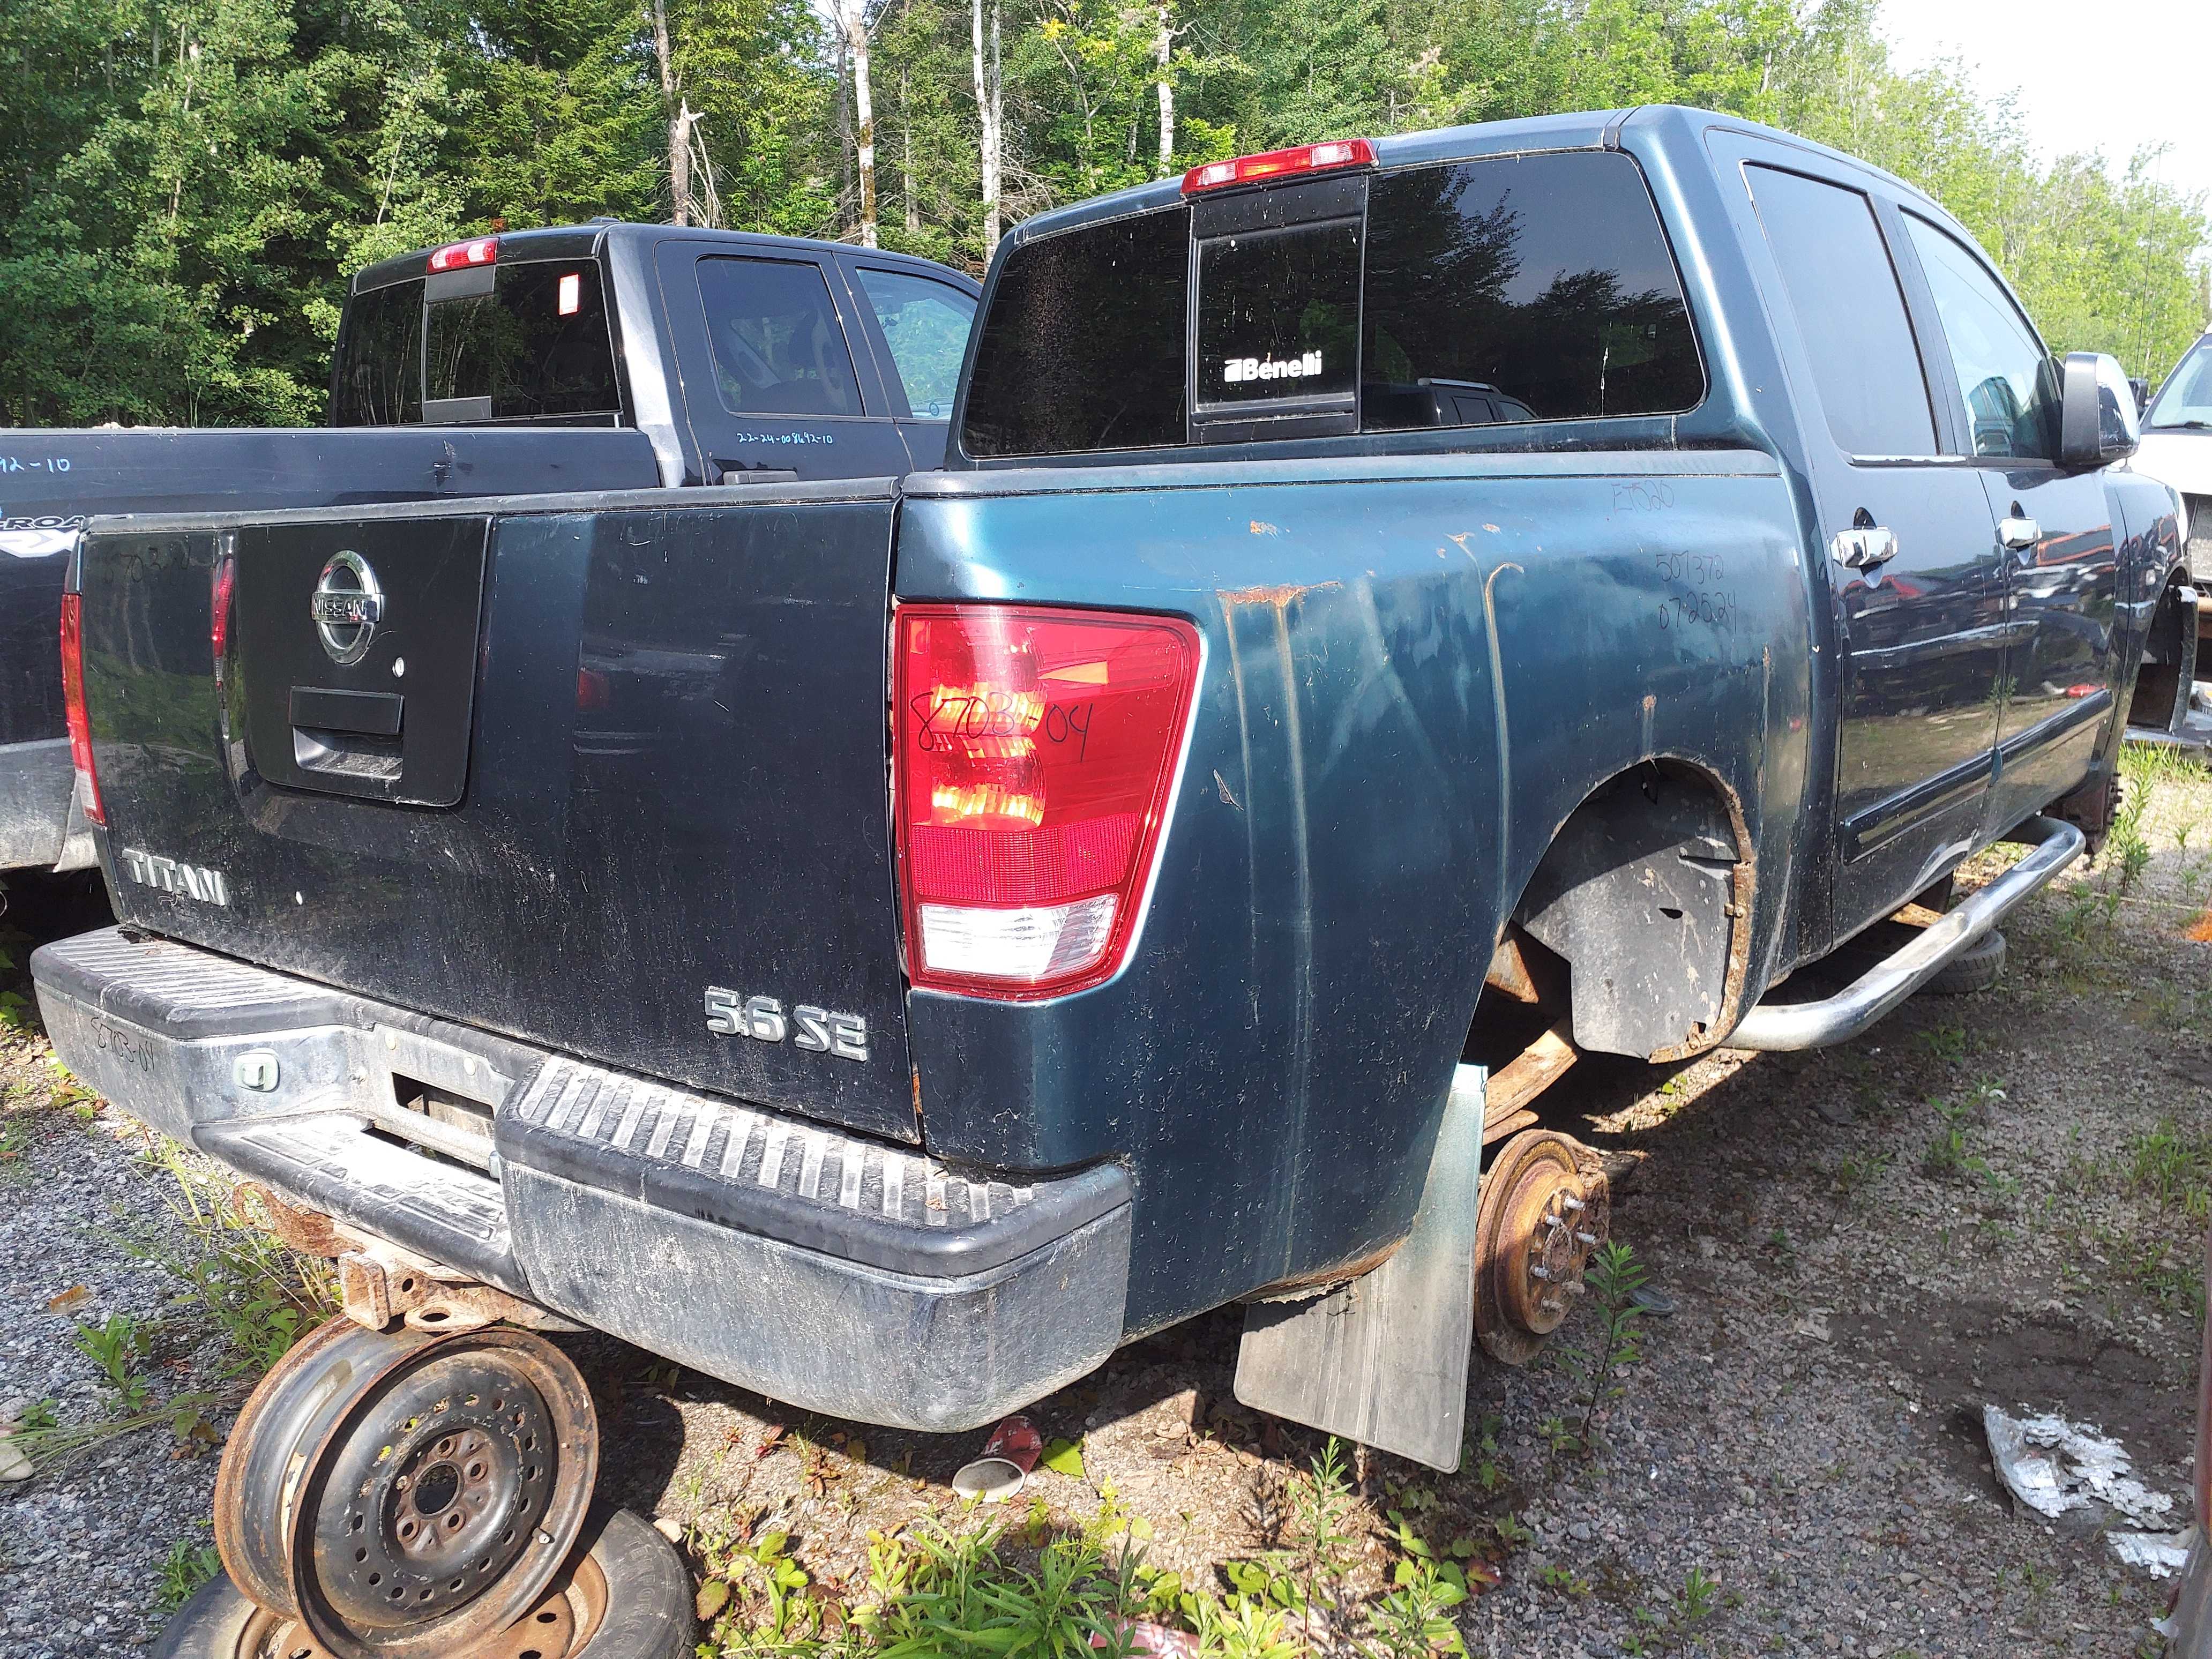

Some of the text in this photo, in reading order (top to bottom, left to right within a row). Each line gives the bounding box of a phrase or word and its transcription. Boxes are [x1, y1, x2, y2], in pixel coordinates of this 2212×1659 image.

[1242, 350, 1322, 381] Benelli
[313, 599, 367, 619] NISSAN
[910, 691, 1094, 764] 8703-04
[122, 848, 226, 906] TITAN
[793, 1005, 867, 1062] SE
